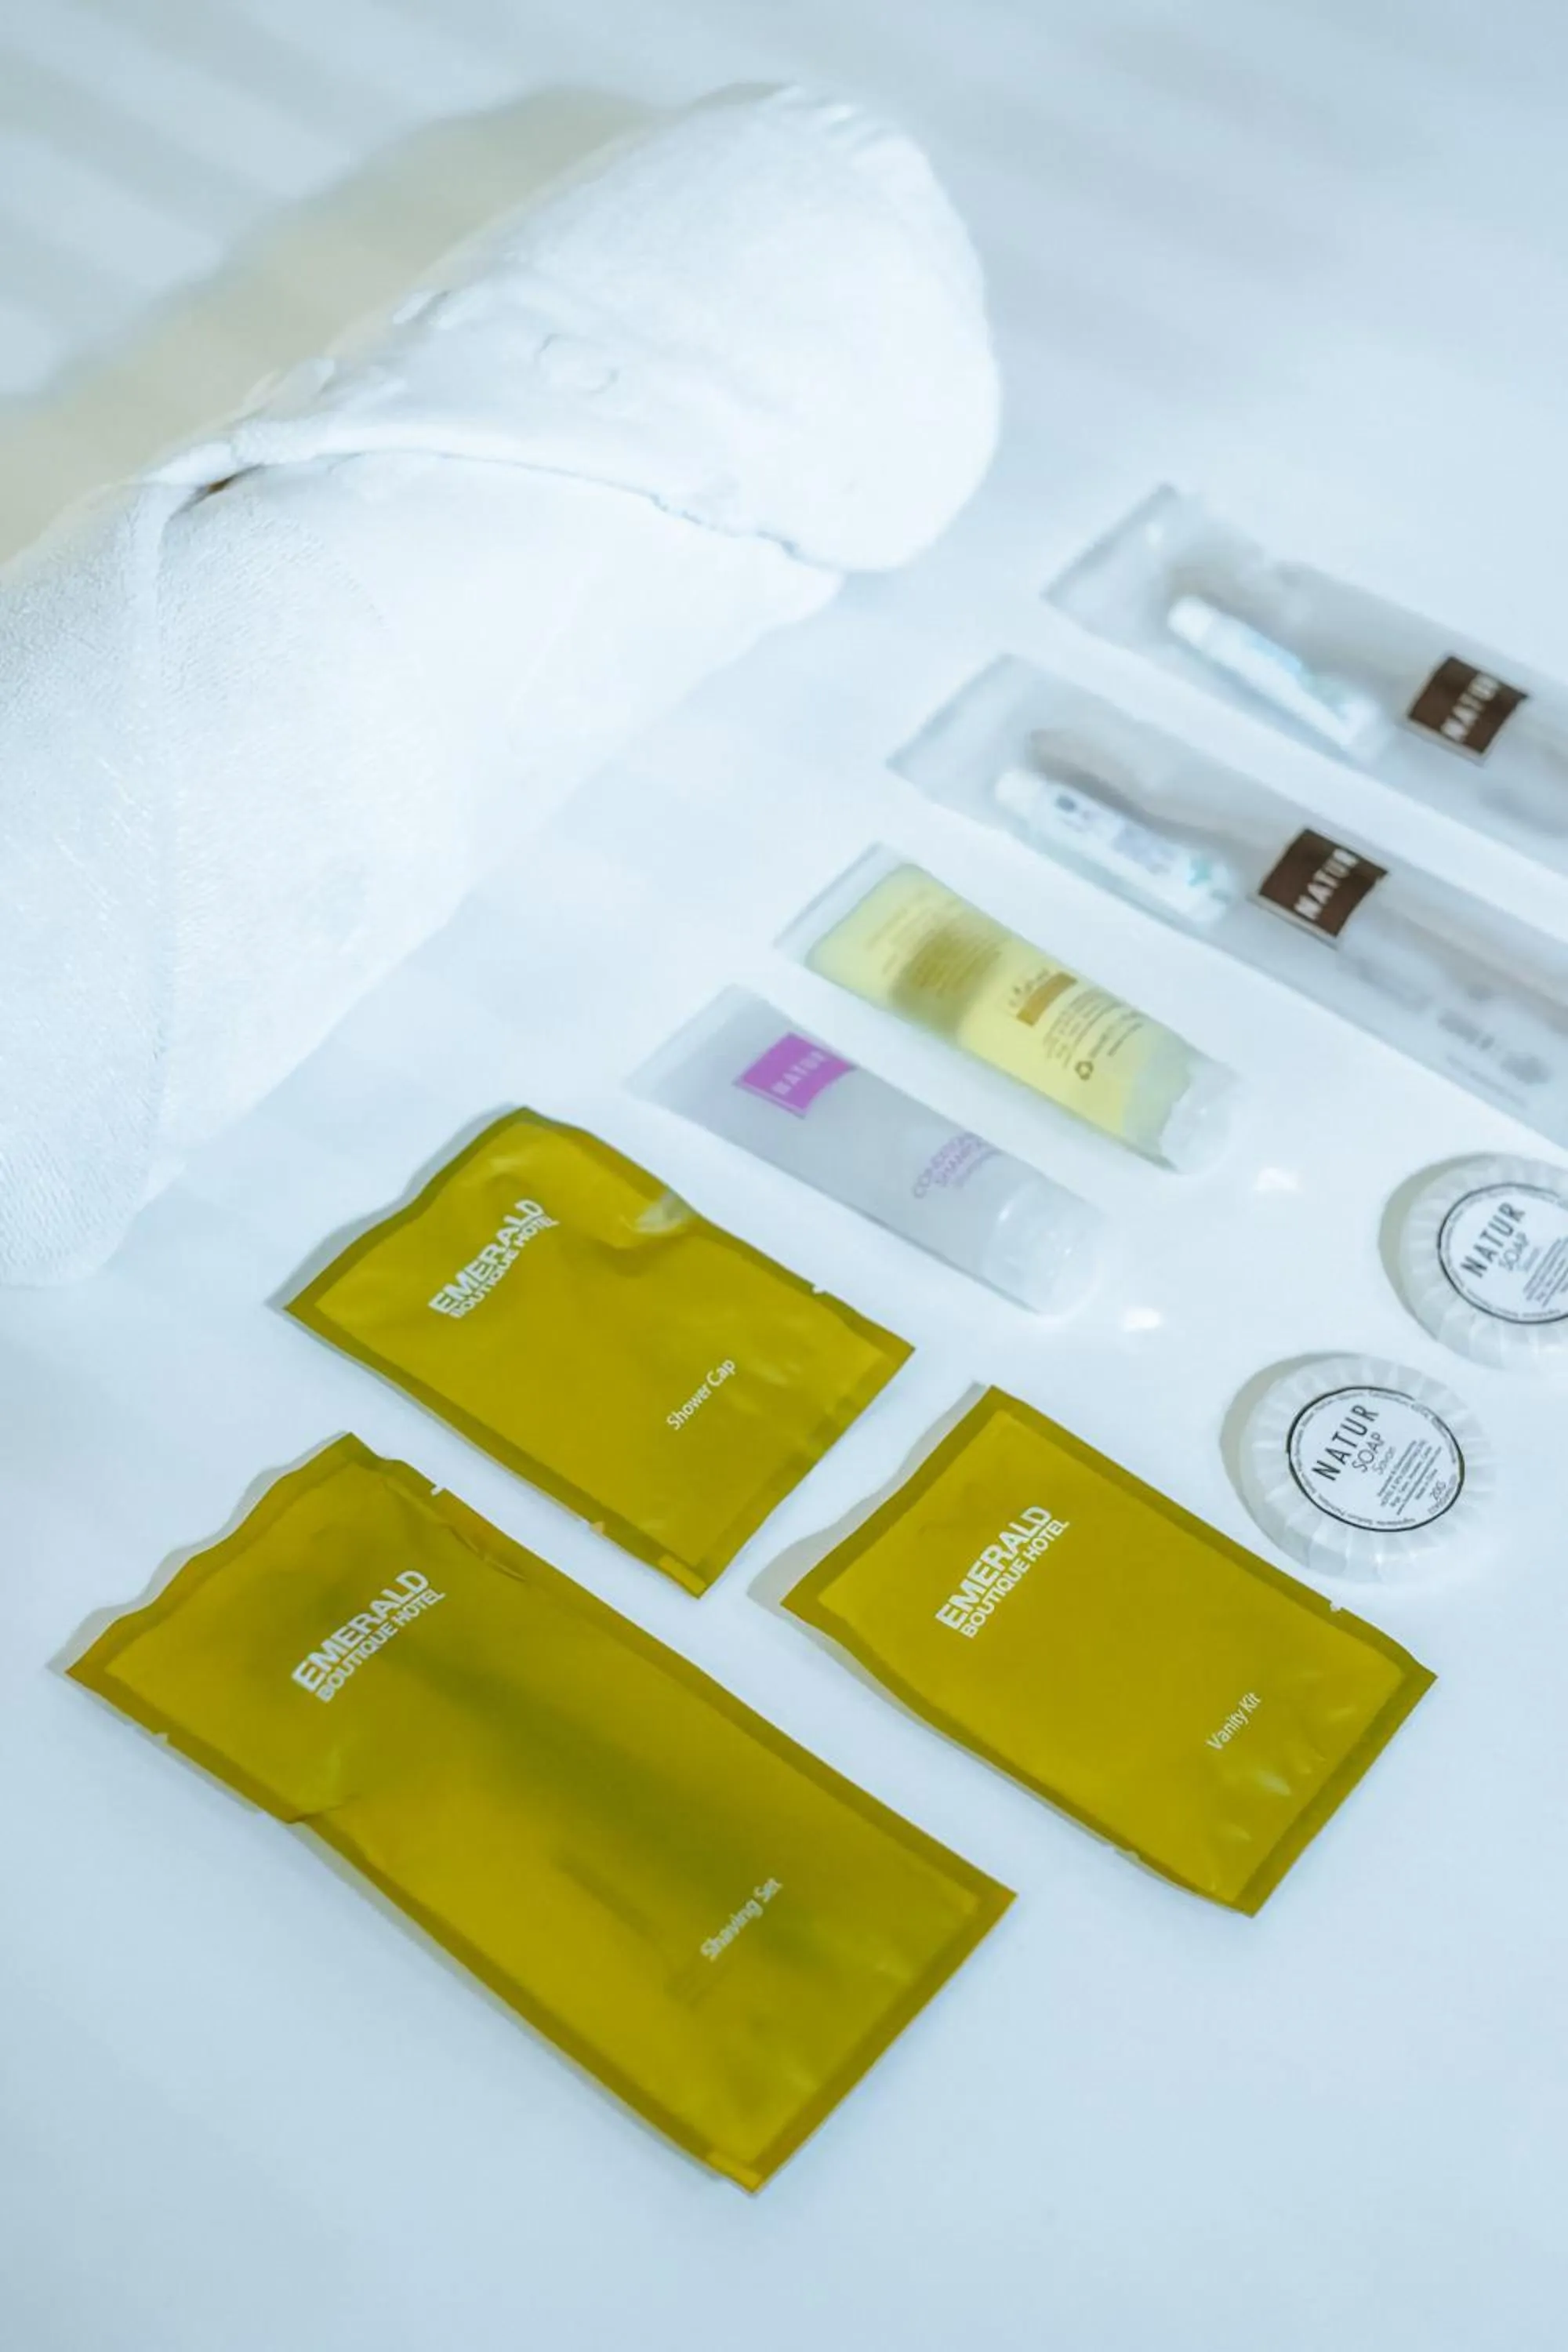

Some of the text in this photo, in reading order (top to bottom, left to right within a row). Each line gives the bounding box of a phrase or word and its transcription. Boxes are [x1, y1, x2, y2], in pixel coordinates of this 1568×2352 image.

[1294, 848, 1359, 920] NATUR
[428, 1200, 543, 1314] EMERALD
[1460, 1202, 1526, 1279] NATUR
[1498, 1232, 1529, 1271] SOAP
[448, 1250, 520, 1319] BOUTIQUE
[666, 1359, 735, 1430] Shower Cap
[1312, 1405, 1379, 1481] NATUR
[1352, 1432, 1385, 1473] SOAP
[935, 1506, 1051, 1630] EMERALD
[960, 1520, 1070, 1639] BOUTIQUE HOTEL
[292, 1570, 429, 1693] EMERALD
[316, 1588, 445, 1703] BOUTIQUE HOTEL
[1207, 1693, 1261, 1749] Vanity Kit
[700, 1878, 782, 1962] Shaving Set
